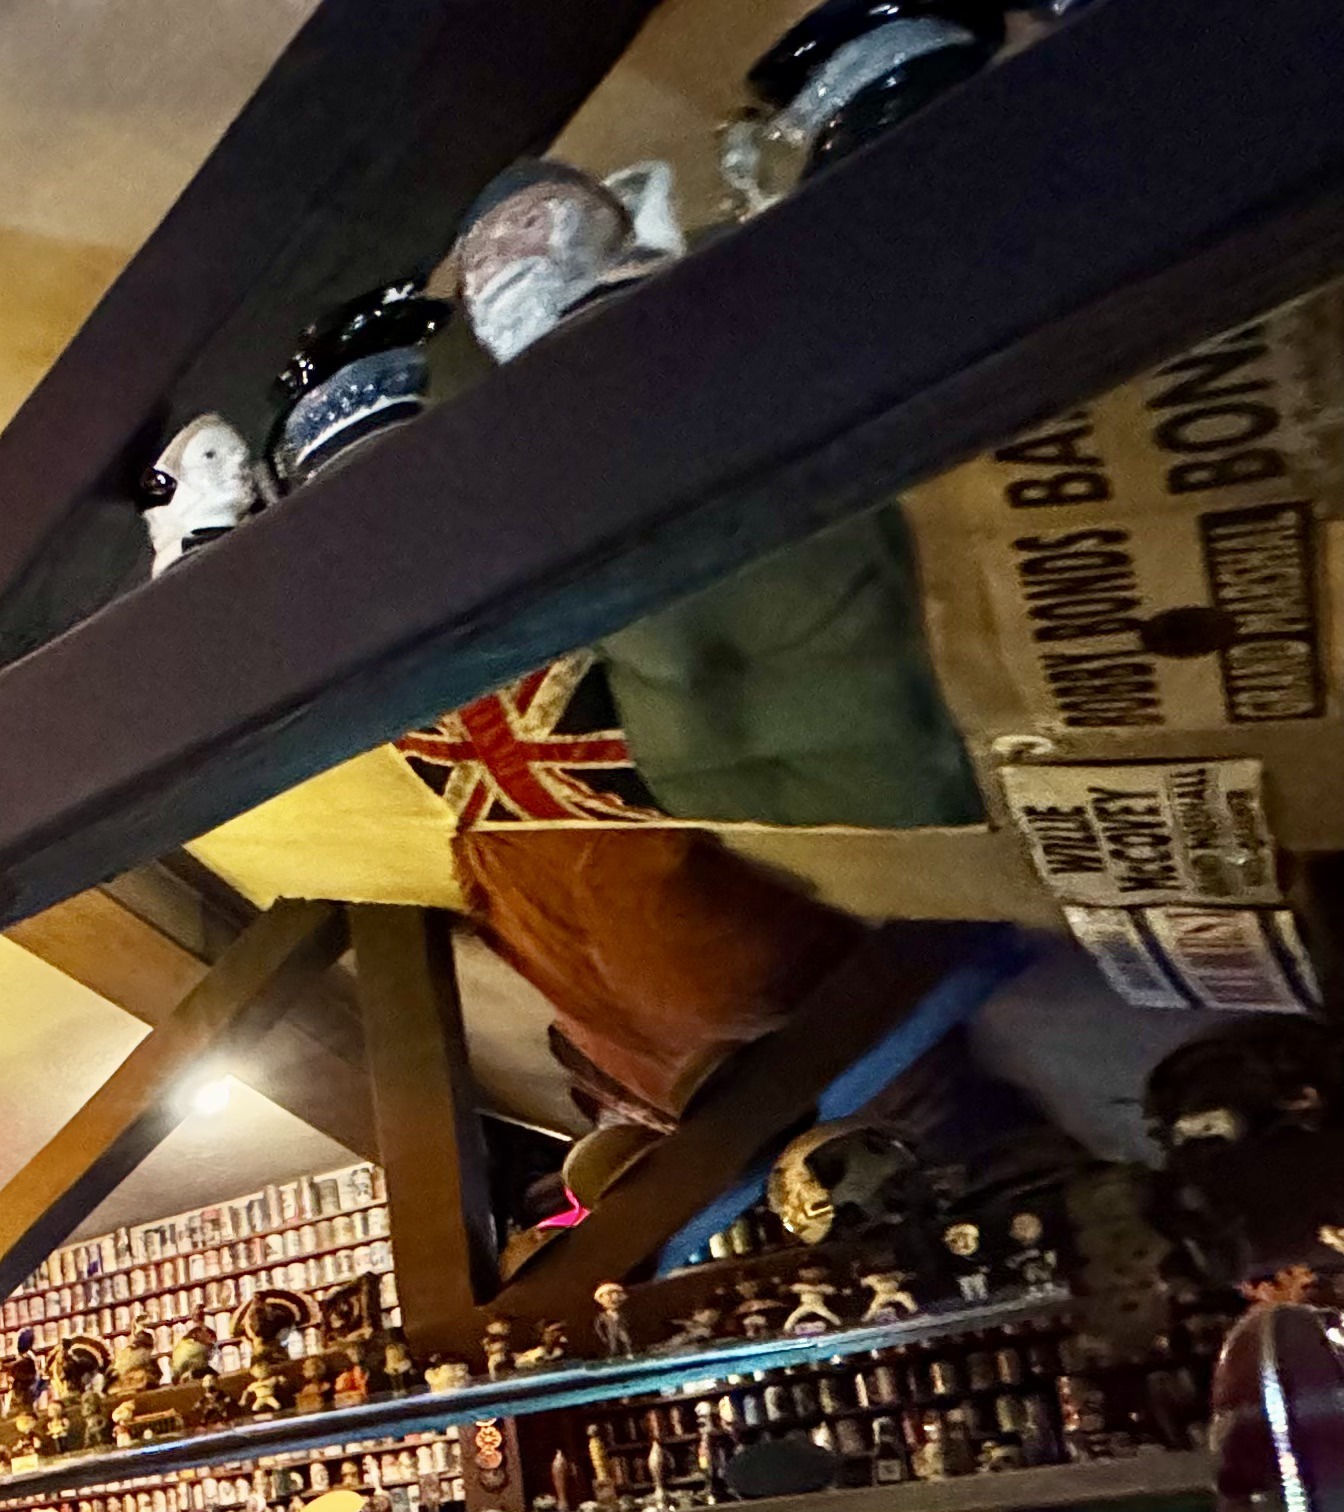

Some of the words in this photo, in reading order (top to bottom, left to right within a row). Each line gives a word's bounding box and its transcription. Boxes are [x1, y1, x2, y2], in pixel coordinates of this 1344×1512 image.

[996, 411, 1109, 508] BA
[1146, 330, 1287, 494] BON
[1023, 805, 1105, 875] WILLIE
